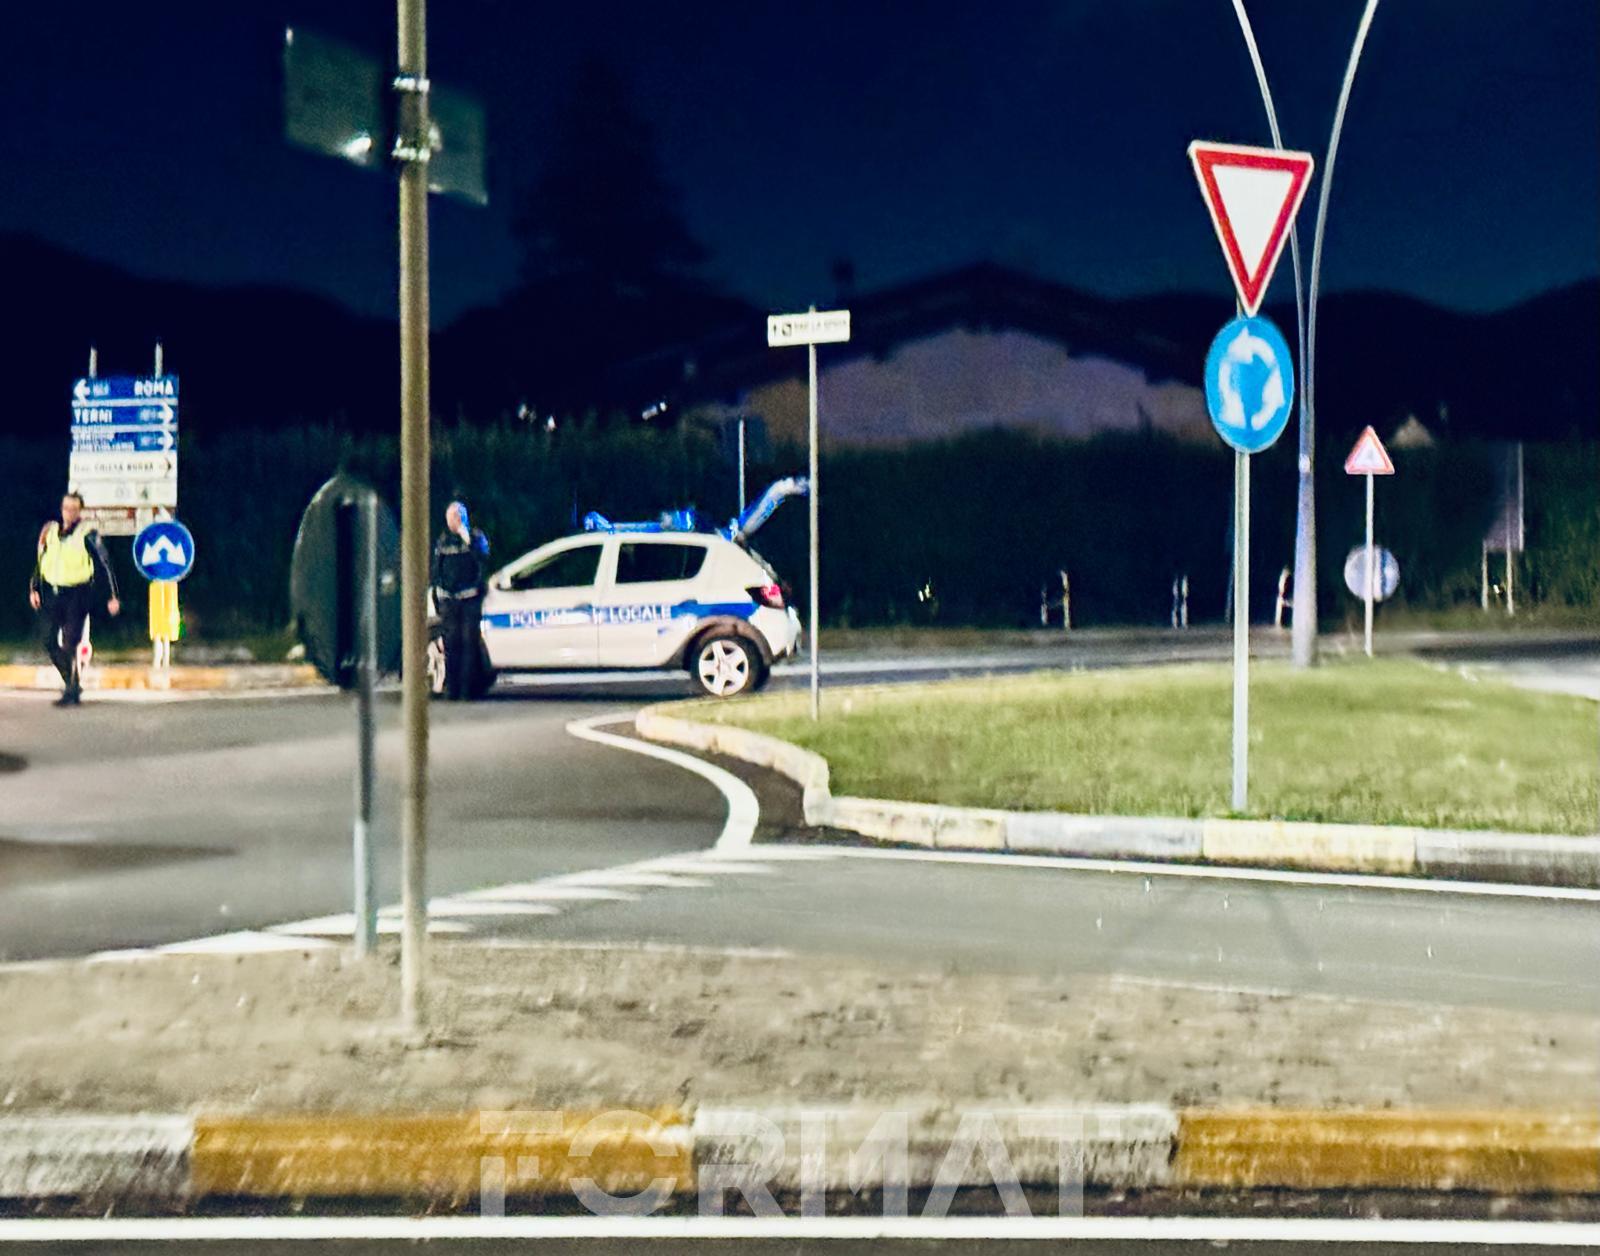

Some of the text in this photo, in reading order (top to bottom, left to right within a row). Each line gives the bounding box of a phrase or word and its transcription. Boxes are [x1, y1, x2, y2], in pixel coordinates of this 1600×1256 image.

[133, 380, 174, 396] ROMA
[74, 407, 113, 424] TERNI
[509, 603, 671, 628] POLI LOCALE
